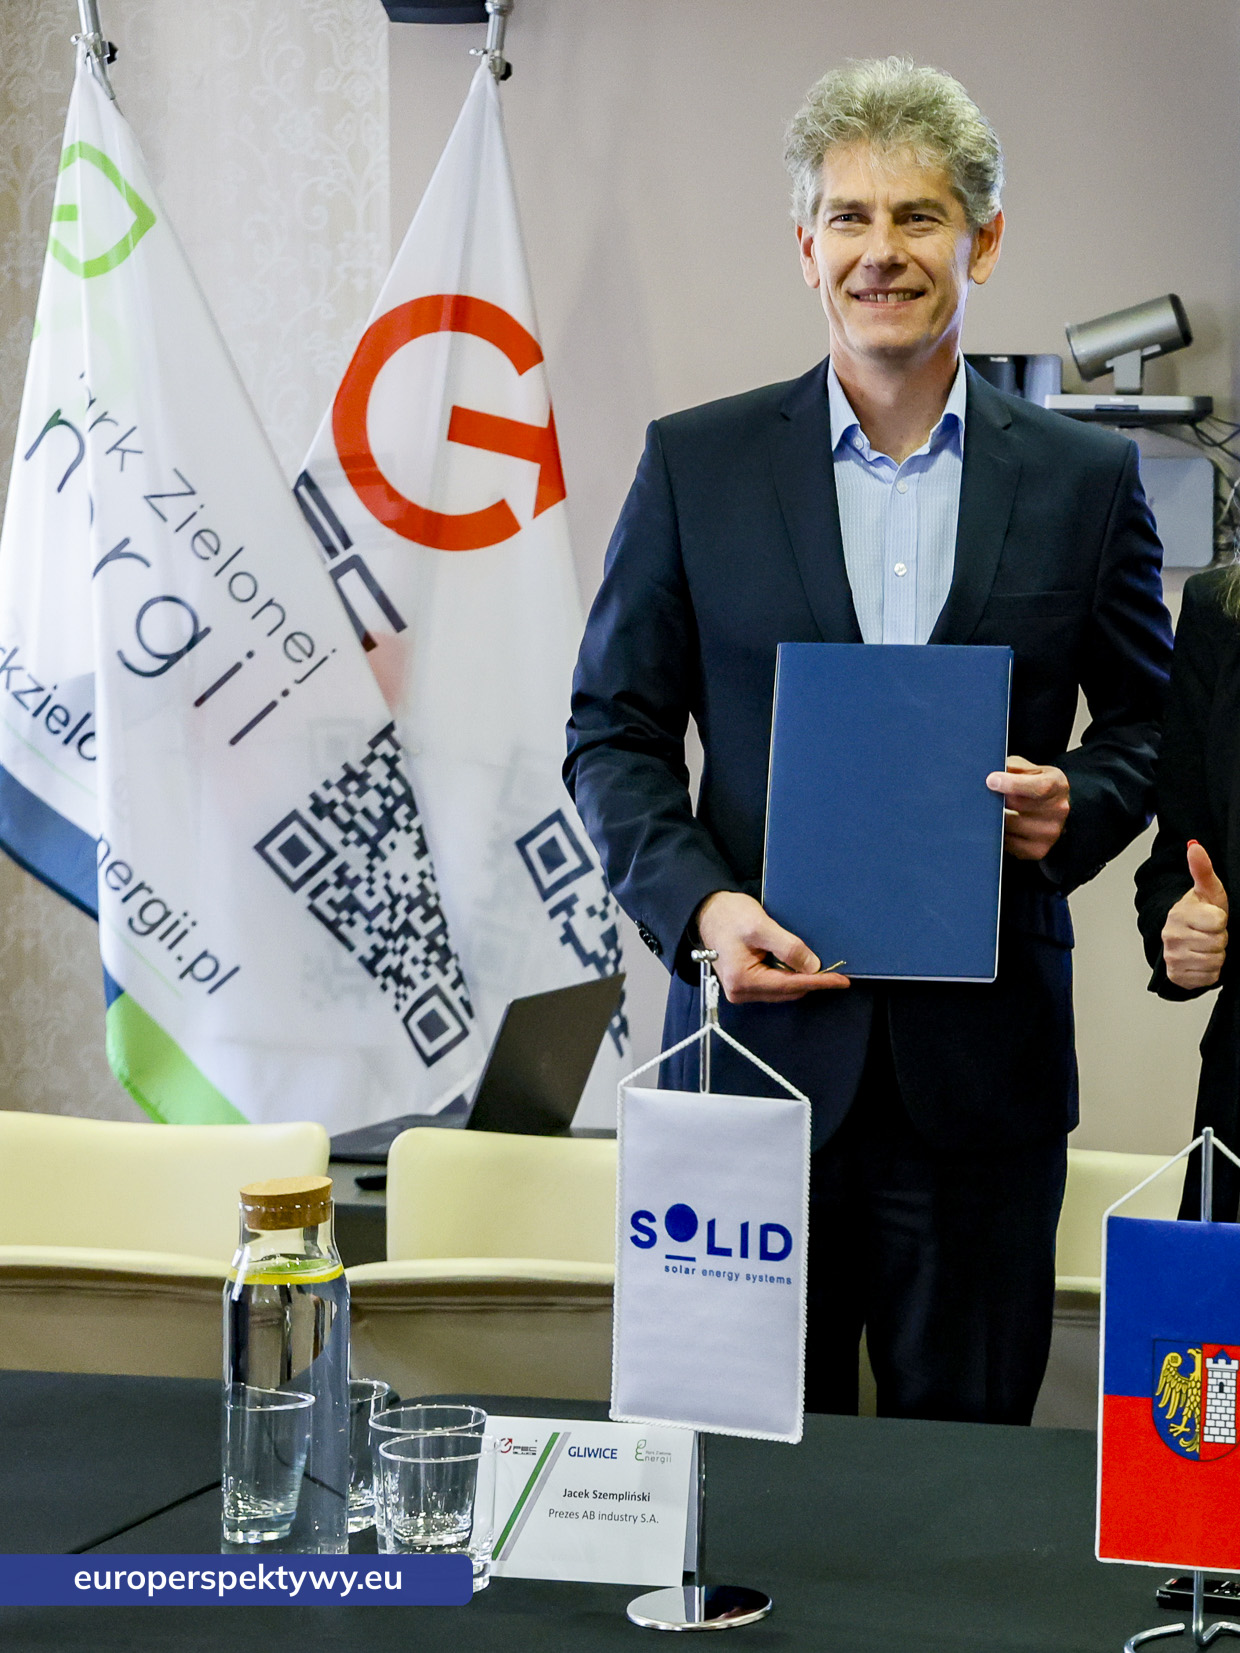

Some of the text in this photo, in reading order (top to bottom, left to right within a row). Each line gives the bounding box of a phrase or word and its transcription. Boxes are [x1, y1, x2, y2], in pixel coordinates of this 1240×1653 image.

[143, 467, 338, 685] Zielonej
[629, 1202, 794, 1262] SOLID
[664, 1264, 793, 1286] solar energy systems
[567, 1445, 619, 1460] GLIWICE
[562, 1488, 651, 1503] Jacek Szempliński
[548, 1507, 660, 1525] Prezes AB industry S.A.
